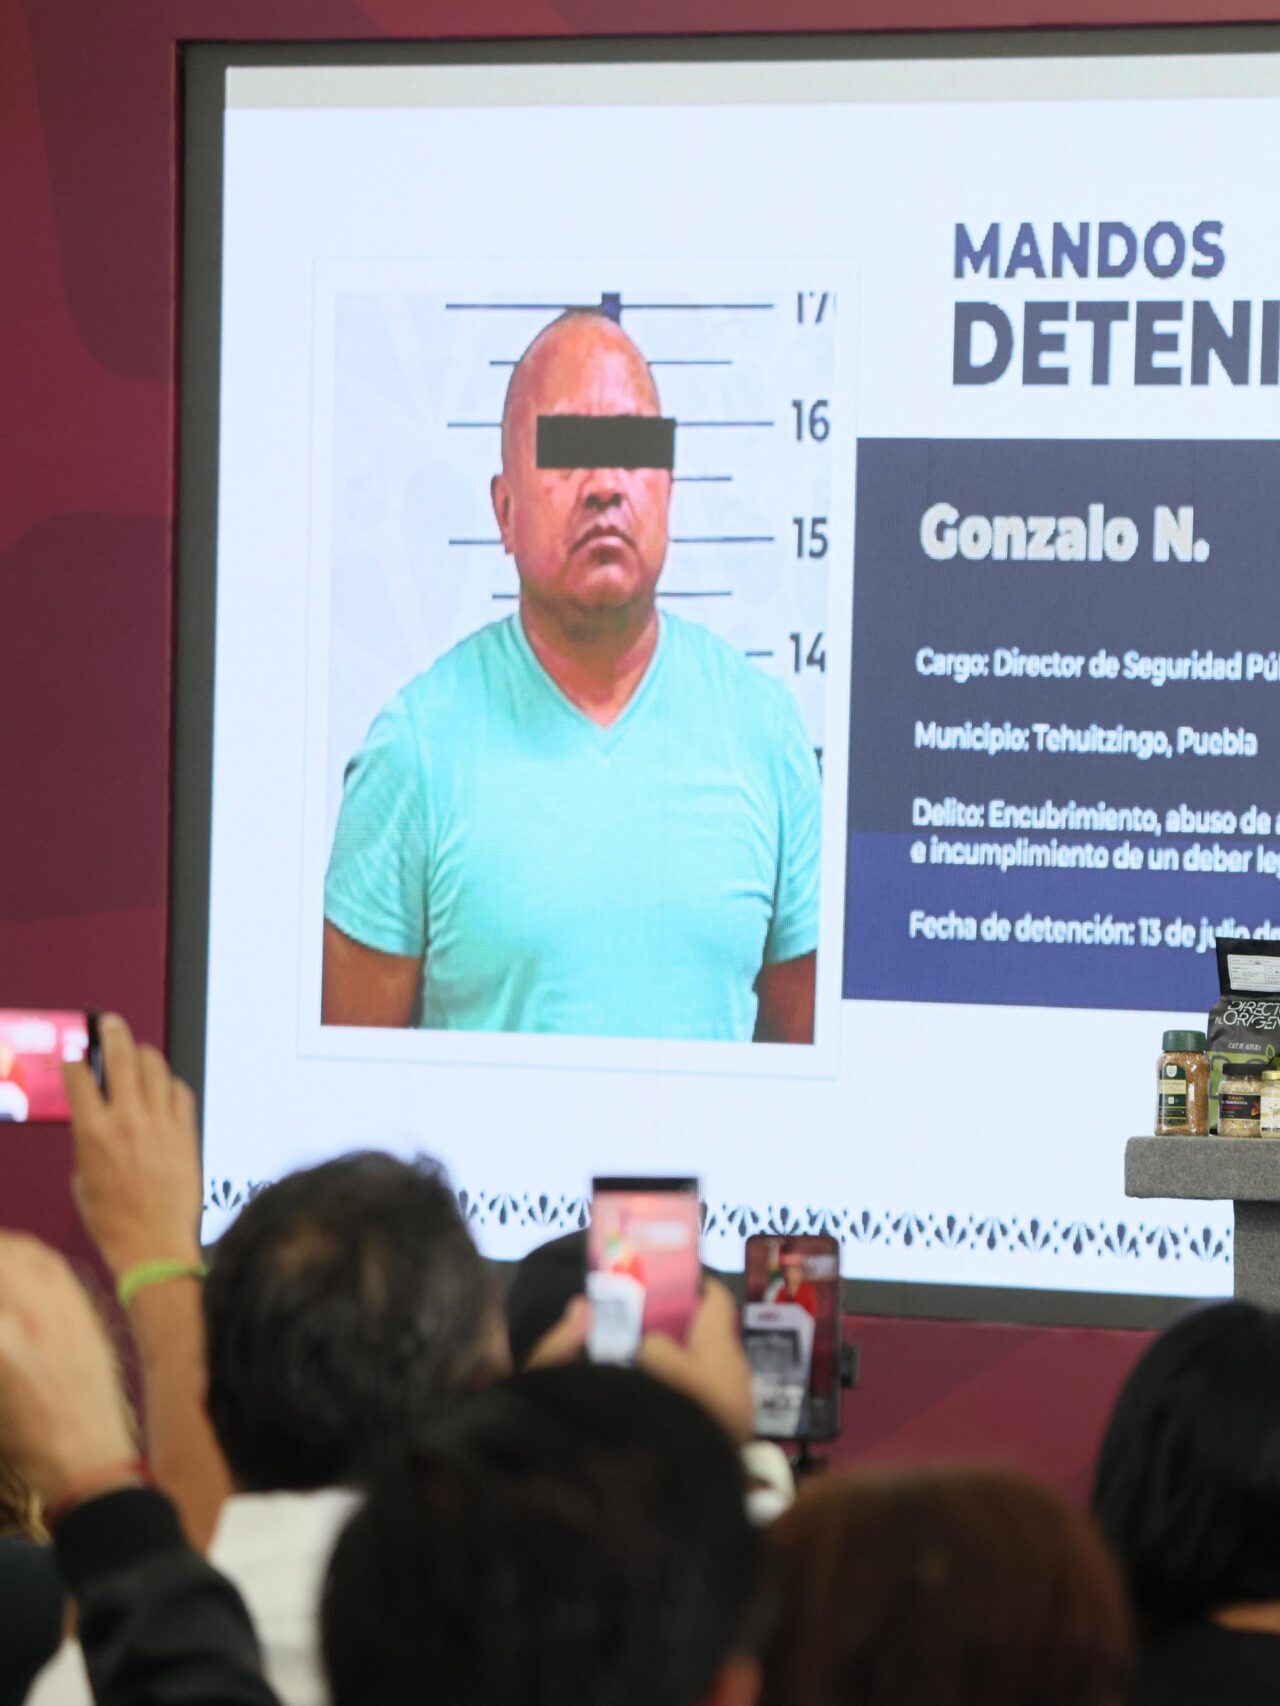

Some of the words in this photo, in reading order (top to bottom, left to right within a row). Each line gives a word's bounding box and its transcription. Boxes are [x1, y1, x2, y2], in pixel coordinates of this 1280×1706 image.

[953, 220, 1226, 280] MANDOS
[792, 399, 830, 442] 16
[792, 516, 829, 560] 15
[920, 502, 1140, 562] Gonzalo
[1153, 505, 1210, 563] N.
[789, 632, 827, 673] 14
[915, 647, 989, 684] Cargo:
[993, 646, 1086, 678] Director
[1088, 649, 1120, 679] de
[1122, 649, 1243, 687] Seguridad
[914, 720, 1030, 756] Municipio:
[1032, 723, 1173, 760] Tehuitzingo,
[1176, 726, 1259, 757] Puebla
[912, 796, 985, 828] Delito:
[988, 799, 1162, 837] Encubrimiento,
[1165, 803, 1237, 834] abuso
[1239, 804, 1272, 835] de
[909, 840, 927, 864] e
[929, 835, 1109, 872] incumplimiento
[1112, 841, 1144, 870] de
[1147, 847, 1180, 871] un
[1182, 843, 1253, 873] deber
[909, 910, 977, 941] Fecha
[980, 911, 1011, 942] de
[1014, 912, 1136, 947] detención:
[1138, 917, 1162, 947] 13
[1164, 917, 1196, 948] de
